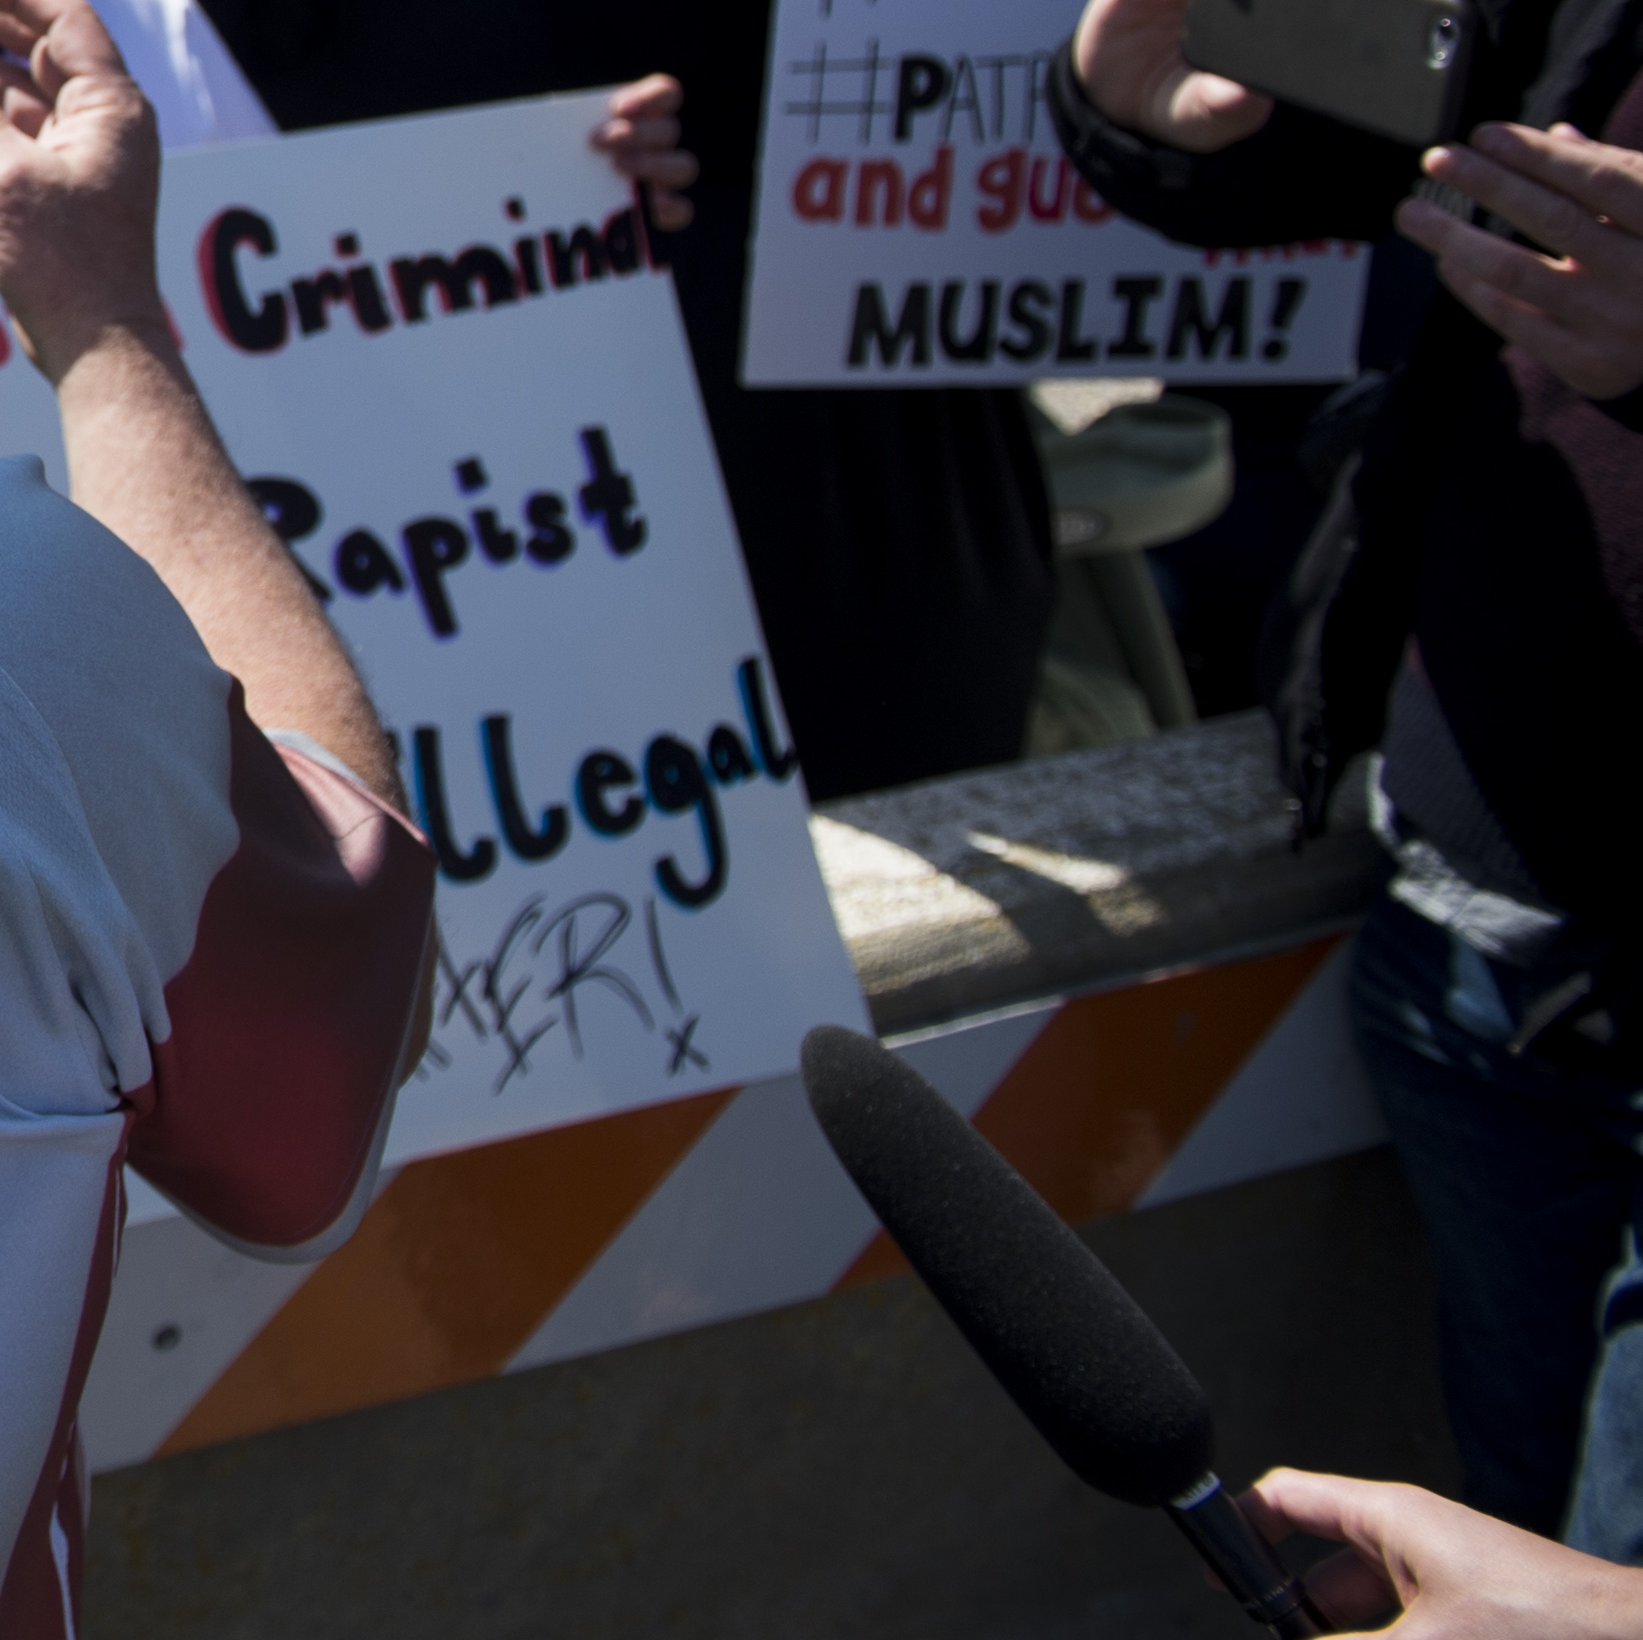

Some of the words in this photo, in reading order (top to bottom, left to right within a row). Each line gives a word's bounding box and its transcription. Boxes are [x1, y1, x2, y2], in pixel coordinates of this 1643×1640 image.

[789, 140, 957, 235] and
[844, 273, 1311, 371] MUSLIM!
[387, 655, 800, 913] llegal
